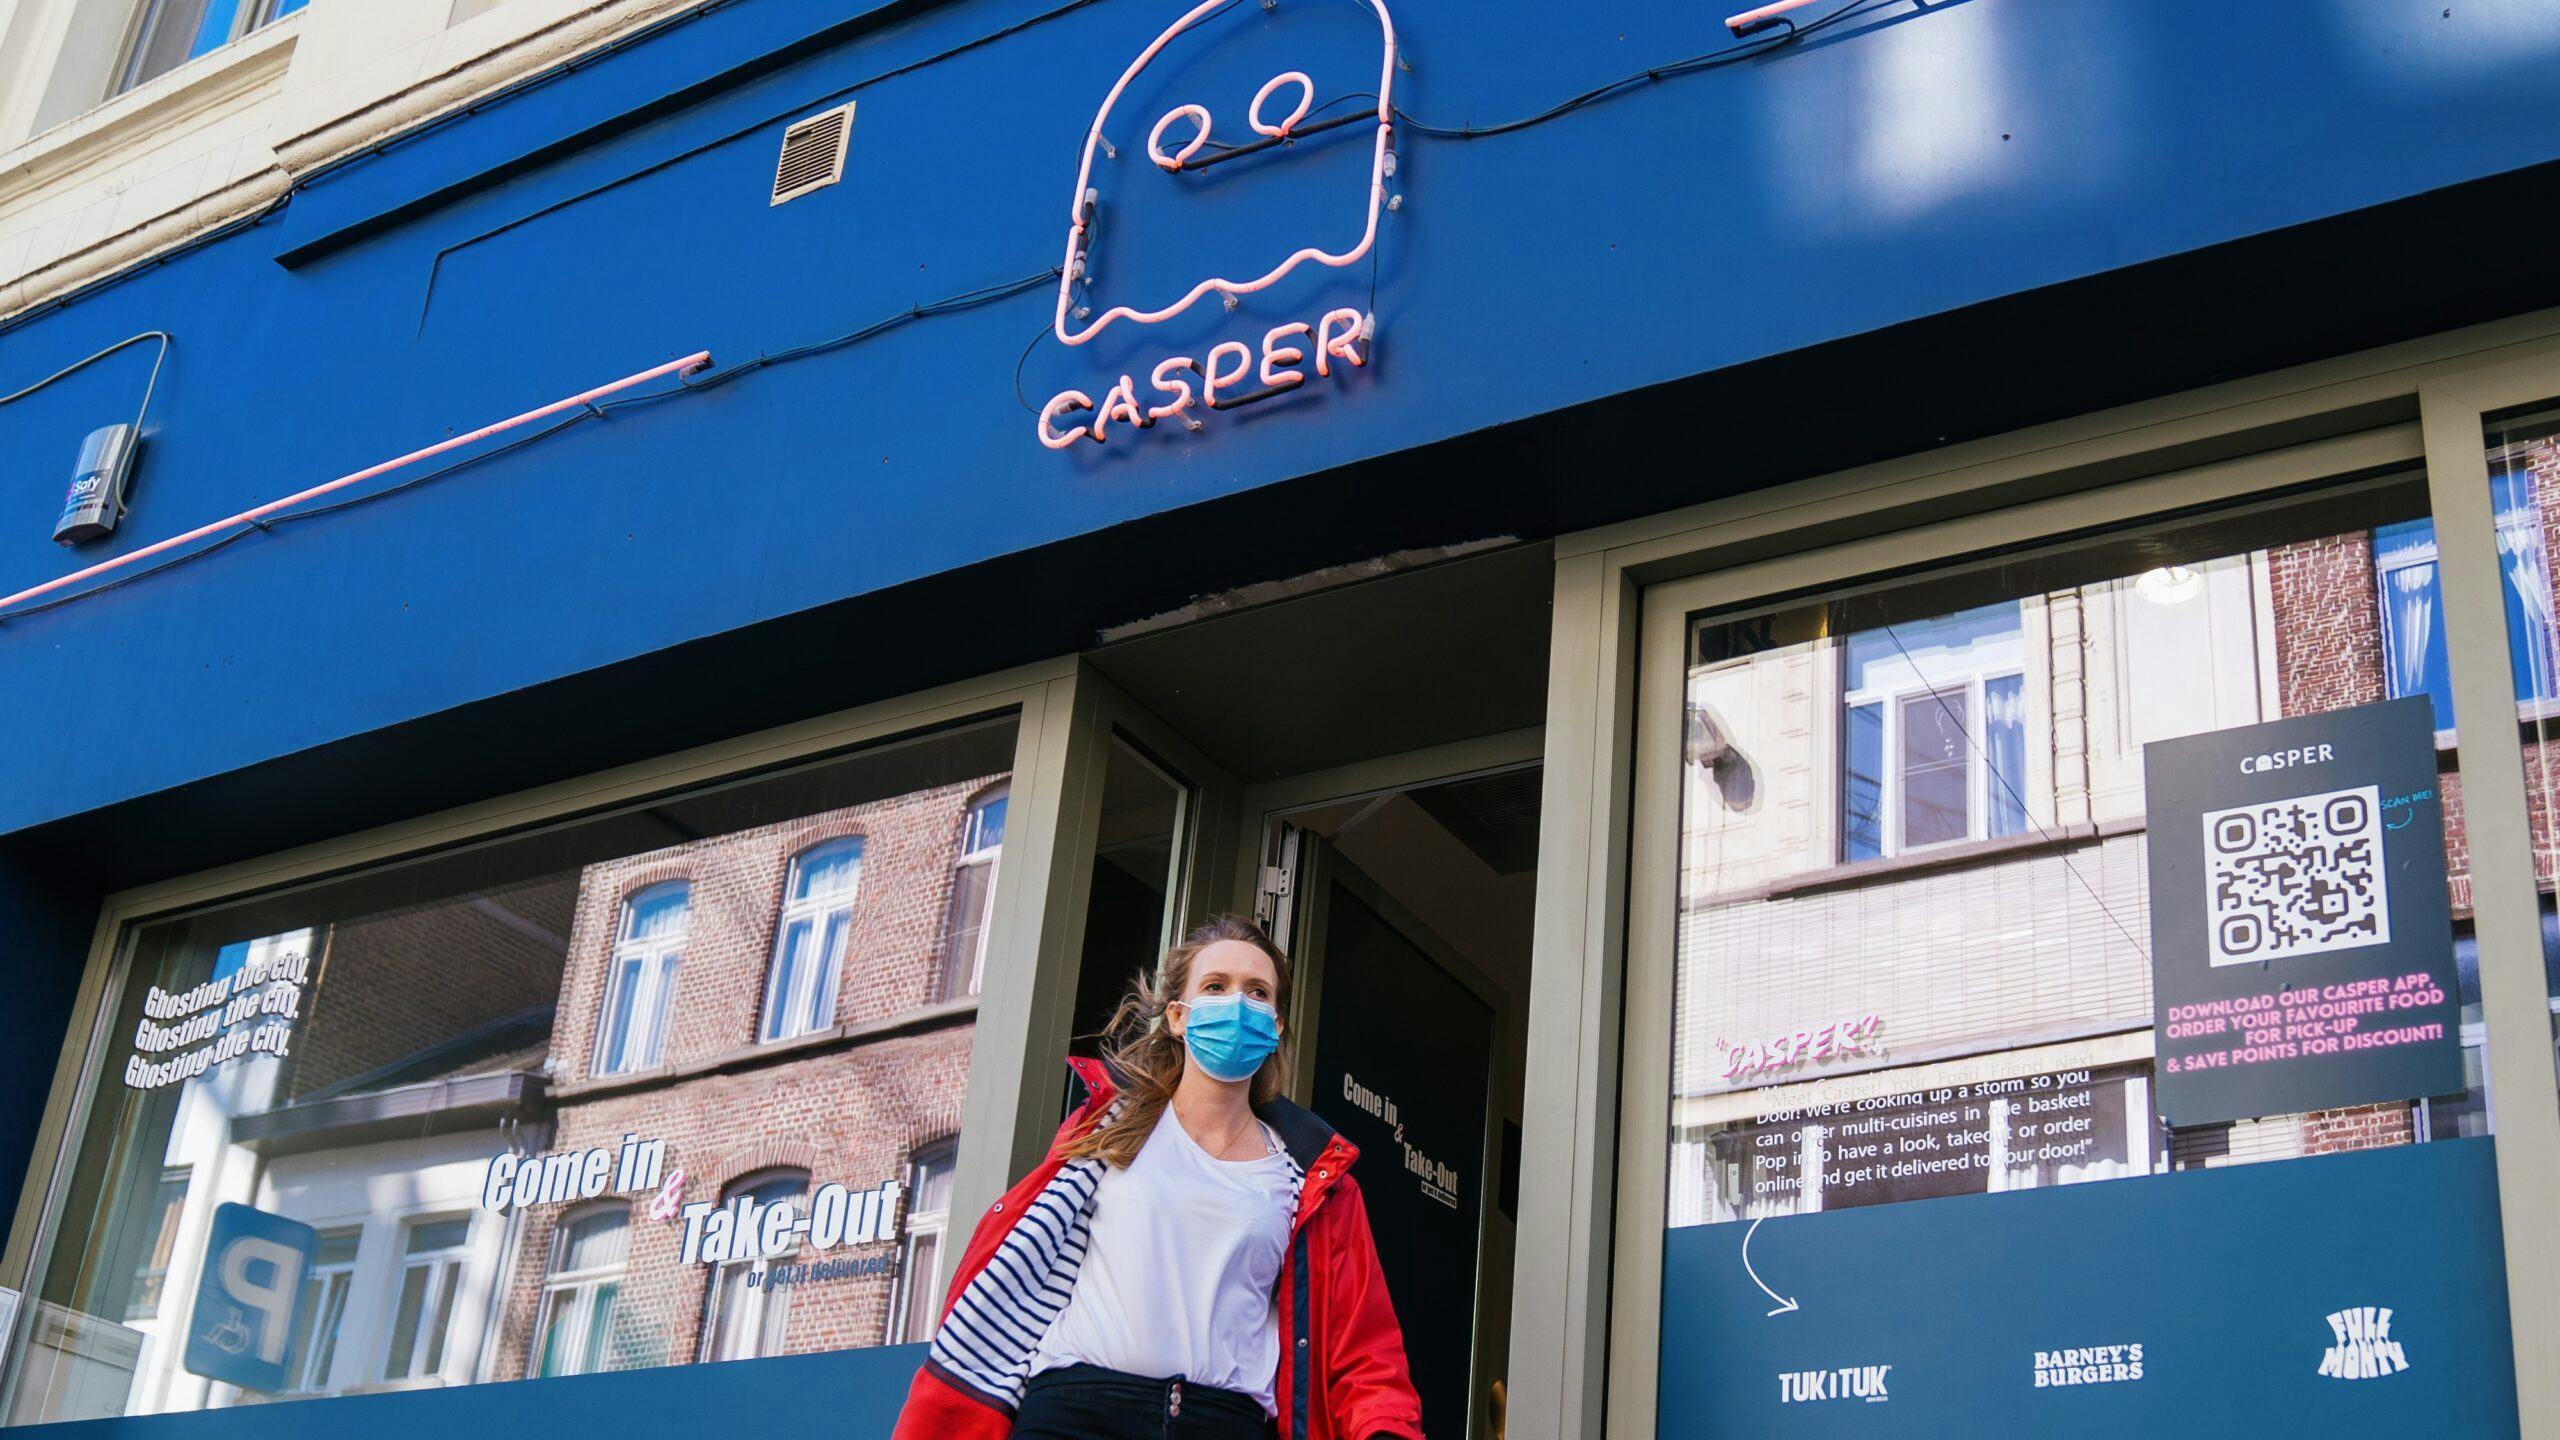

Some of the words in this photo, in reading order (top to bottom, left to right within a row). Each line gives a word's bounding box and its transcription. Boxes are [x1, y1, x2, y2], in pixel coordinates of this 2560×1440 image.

[1037, 308, 1364, 449] CASPER
[2381, 795, 2410, 810] SCAN
[144, 975, 232, 1019] Ghosting
[232, 964, 270, 994] the
[269, 951, 311, 985] city.
[2168, 994, 2274, 1021] DOWNLOAD
[2279, 985, 2319, 1007] OUR
[2323, 978, 2389, 1001] CASPER
[134, 1010, 223, 1053] Ghosting
[223, 994, 261, 1028] the
[260, 985, 302, 1020] city.
[2166, 1018, 2227, 1039] ORDER
[2230, 1009, 2282, 1030] YOUR
[2286, 998, 2384, 1023] FAVOURITE
[2389, 989, 2445, 1009] FOOD
[2245, 1028, 2281, 1046] FOR
[2285, 1017, 2359, 1040] PICK-UP
[124, 1045, 213, 1089] Ghosting
[213, 1028, 251, 1065] the
[251, 1021, 292, 1057] city.
[2166, 1058, 2181, 1073] &
[2185, 1050, 2228, 1071] SAVE
[2232, 1042, 2298, 1064] POINTS
[2302, 1037, 2339, 1056] FOR
[2343, 1023, 2444, 1050] DISCOUNT!
[1343, 1073, 1382, 1118] Come
[1384, 1096, 1398, 1127] in
[1756, 1107, 1800, 1125] Door!
[1806, 1101, 1850, 1118] We're
[1857, 1091, 1923, 1112] cooking
[1929, 1087, 1952, 1105] up
[1958, 1086, 1968, 1099] a
[1975, 1079, 2024, 1096] storm
[2031, 1075, 2051, 1089] so
[2056, 1070, 2090, 1090] you
[1756, 1132, 1784, 1147] can
[1791, 1122, 1835, 1143] oer
[1842, 1110, 1958, 1137] multi-cuisines
[1965, 1106, 1981, 1121] in
[2028, 1090, 2091, 1114] basket!
[1394, 1123, 1404, 1143] &
[1756, 1153, 1787, 1172] Pop
[1793, 1147, 1832, 1166] ino
[1838, 1143, 1878, 1160] have
[1883, 1142, 1893, 1155] a
[1900, 1133, 1941, 1154] look,
[1946, 1126, 2013, 1148] takeot
[2019, 1124, 2038, 1139] or
[2044, 1116, 2092, 1134] order
[483, 1147, 611, 1212] Come
[615, 1133, 666, 1193] in
[650, 1168, 686, 1222] &
[1404, 1141, 1458, 1195] Take-Out
[1755, 1174, 1806, 1194] online
[1844, 1164, 1872, 1186] get
[1876, 1163, 1888, 1179] it
[1891, 1152, 1969, 1177] delivered
[1973, 1154, 1991, 1169] to
[1998, 1147, 2035, 1168] our
[679, 1180, 901, 1265] Take-Out
[747, 1269, 763, 1288] or
[810, 1251, 889, 1282] delivered
[2034, 1343, 2144, 1370] BARNEY'S
[2034, 1361, 2144, 1388] BURGERS
